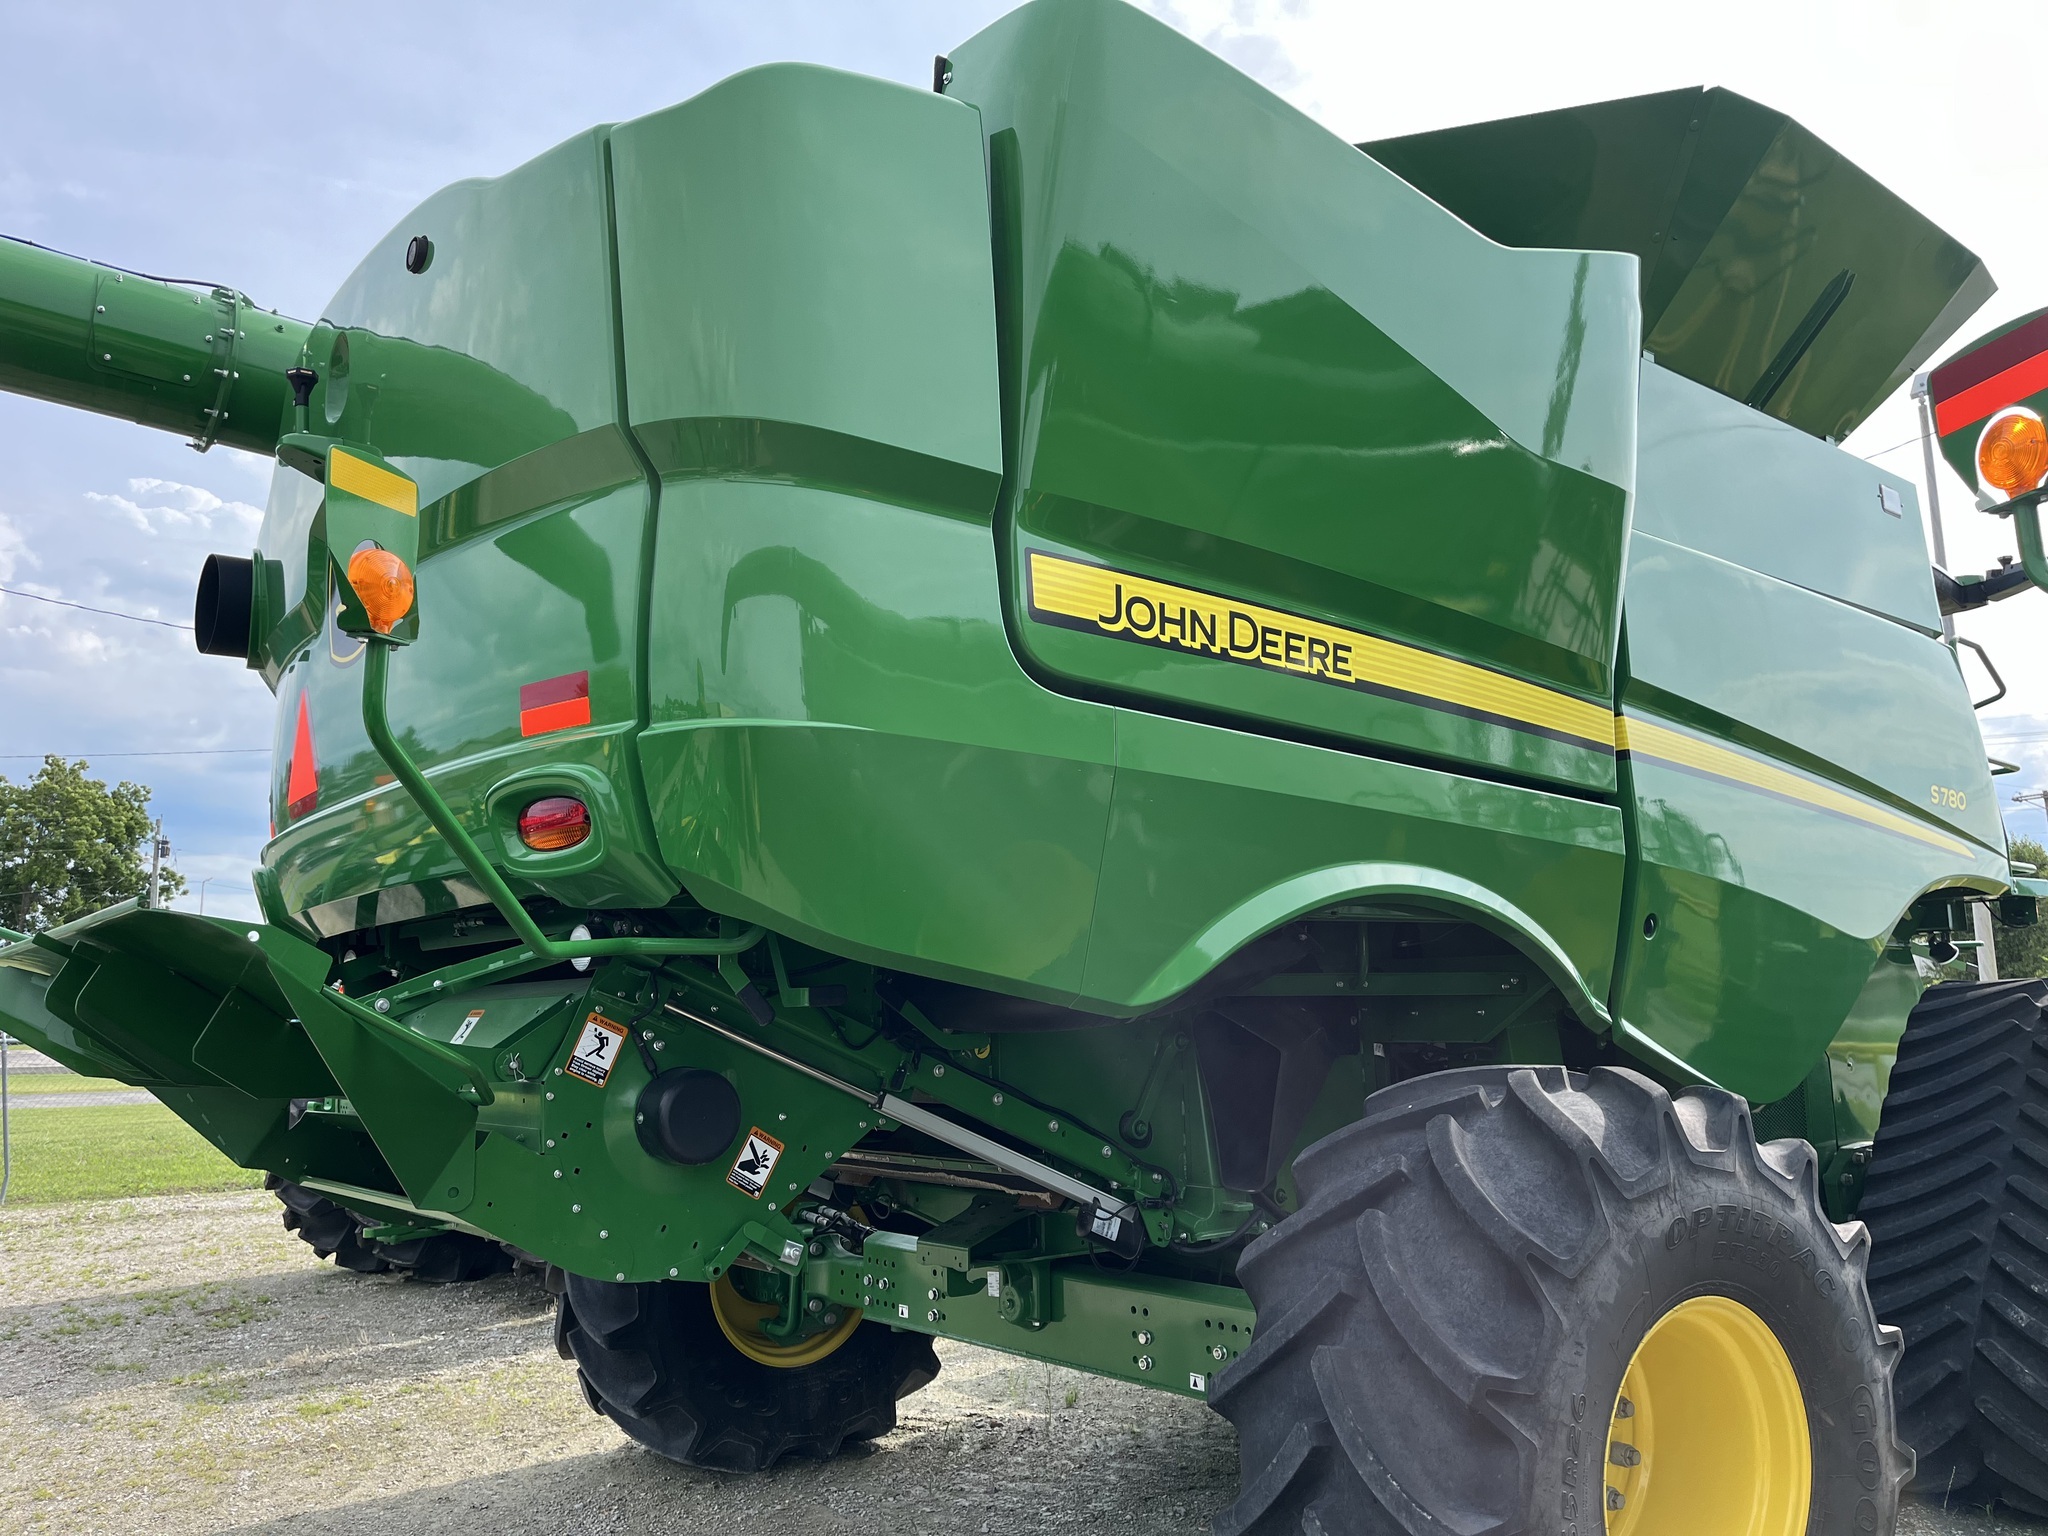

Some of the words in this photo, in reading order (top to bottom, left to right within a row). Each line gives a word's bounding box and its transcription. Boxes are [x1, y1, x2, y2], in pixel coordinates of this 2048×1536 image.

[1097, 583, 1217, 647] JOHN
[1227, 609, 1354, 677] DEERE
[1931, 785, 1966, 811] S780
[599, 1018, 624, 1034] WARNING
[759, 1134, 781, 1149] WARNING
[1665, 1203, 1836, 1298] OPTITRAC
